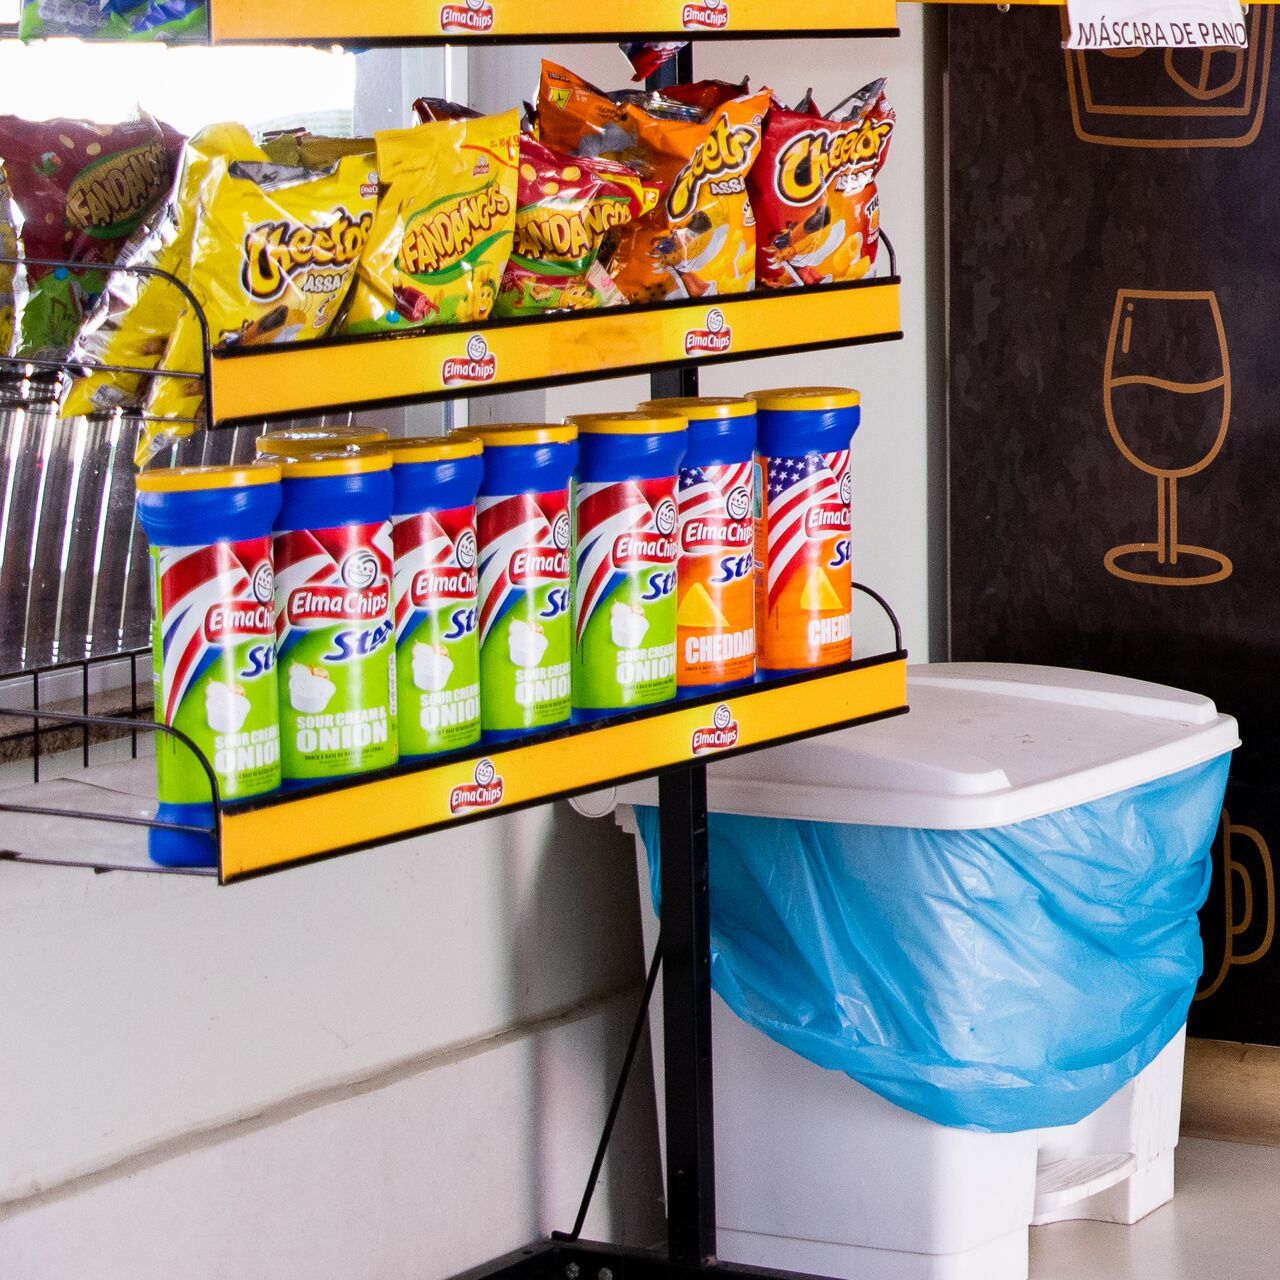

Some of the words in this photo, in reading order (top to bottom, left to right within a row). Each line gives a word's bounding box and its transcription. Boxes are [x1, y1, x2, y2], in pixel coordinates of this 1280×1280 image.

[1078, 16, 1169, 47] MÁSCARA
[1169, 22, 1197, 46] DE
[1197, 22, 1248, 47] PANO
[401, 184, 510, 274] FANDANGOS
[303, 270, 348, 293] ASSA
[685, 627, 753, 663] CHEDDA
[296, 714, 336, 729] SOUR
[296, 720, 388, 753] ONION
